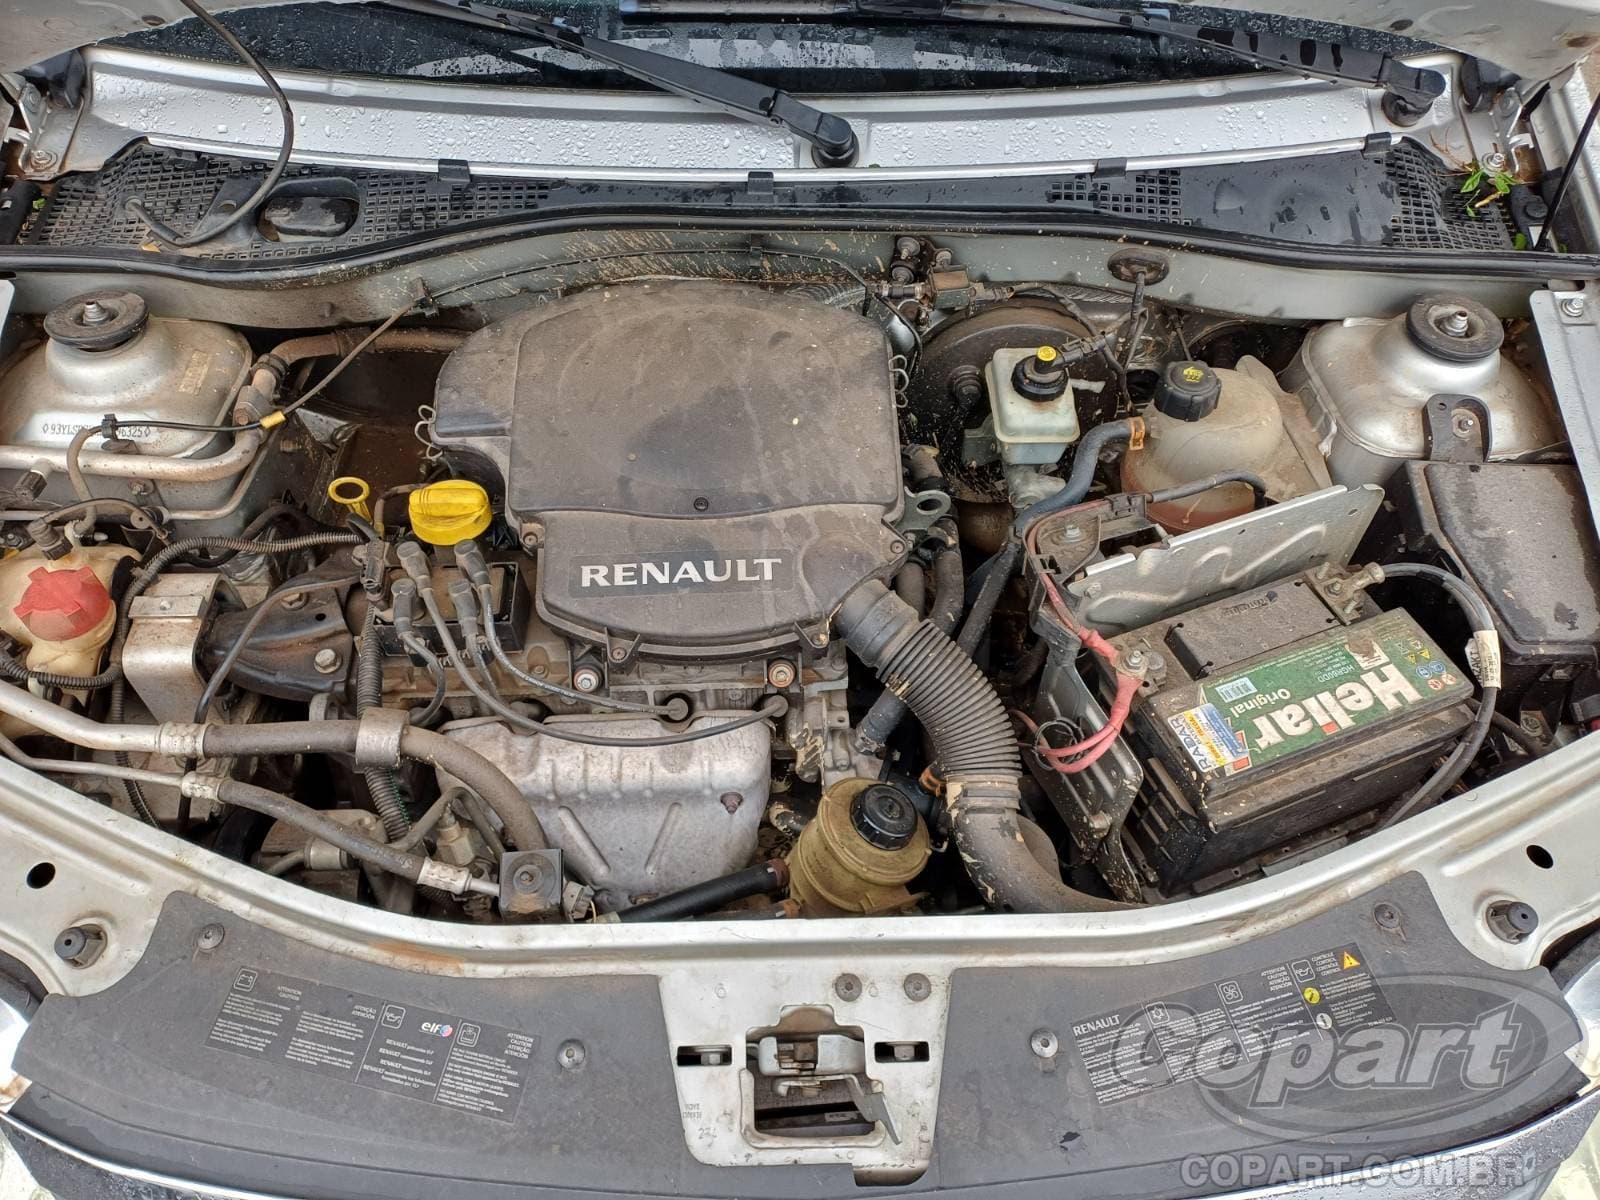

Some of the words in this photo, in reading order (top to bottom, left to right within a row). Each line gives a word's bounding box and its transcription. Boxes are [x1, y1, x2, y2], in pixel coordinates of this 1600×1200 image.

[580, 558, 783, 588] RENAULT
[1230, 688, 1291, 718] Original
[1252, 663, 1424, 751] Heliar
[1171, 718, 1212, 770] RADAR
[421, 1022, 442, 1033] elf
[1073, 1014, 1121, 1037] RENAULT
